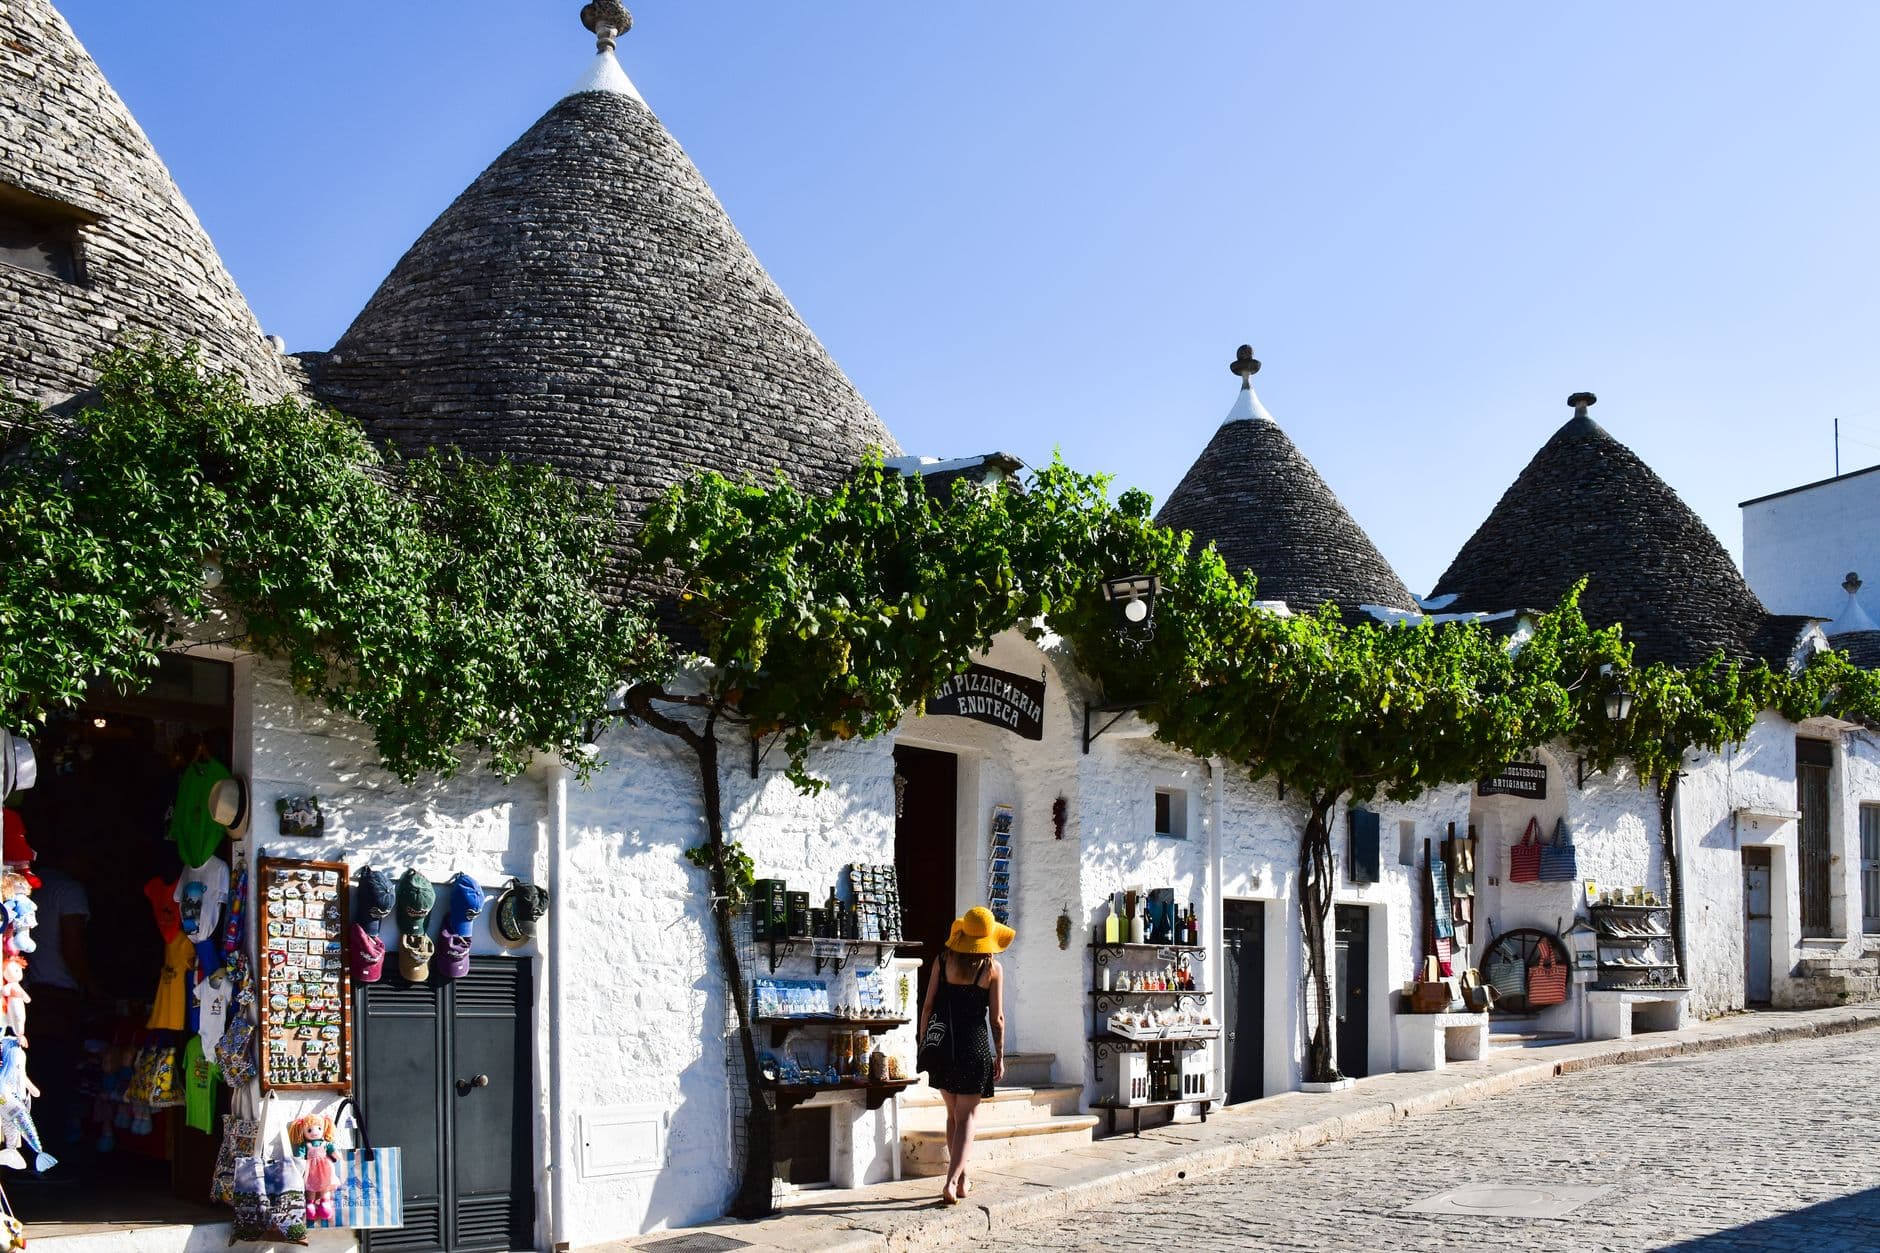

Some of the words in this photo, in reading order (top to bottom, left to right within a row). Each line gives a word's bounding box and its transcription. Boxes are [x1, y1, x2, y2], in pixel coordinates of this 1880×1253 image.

[953, 674, 1041, 723] PIZZICHERIA
[957, 696, 1020, 728] ENOTECA
[1492, 778, 1537, 791] ARTIGIANALE
